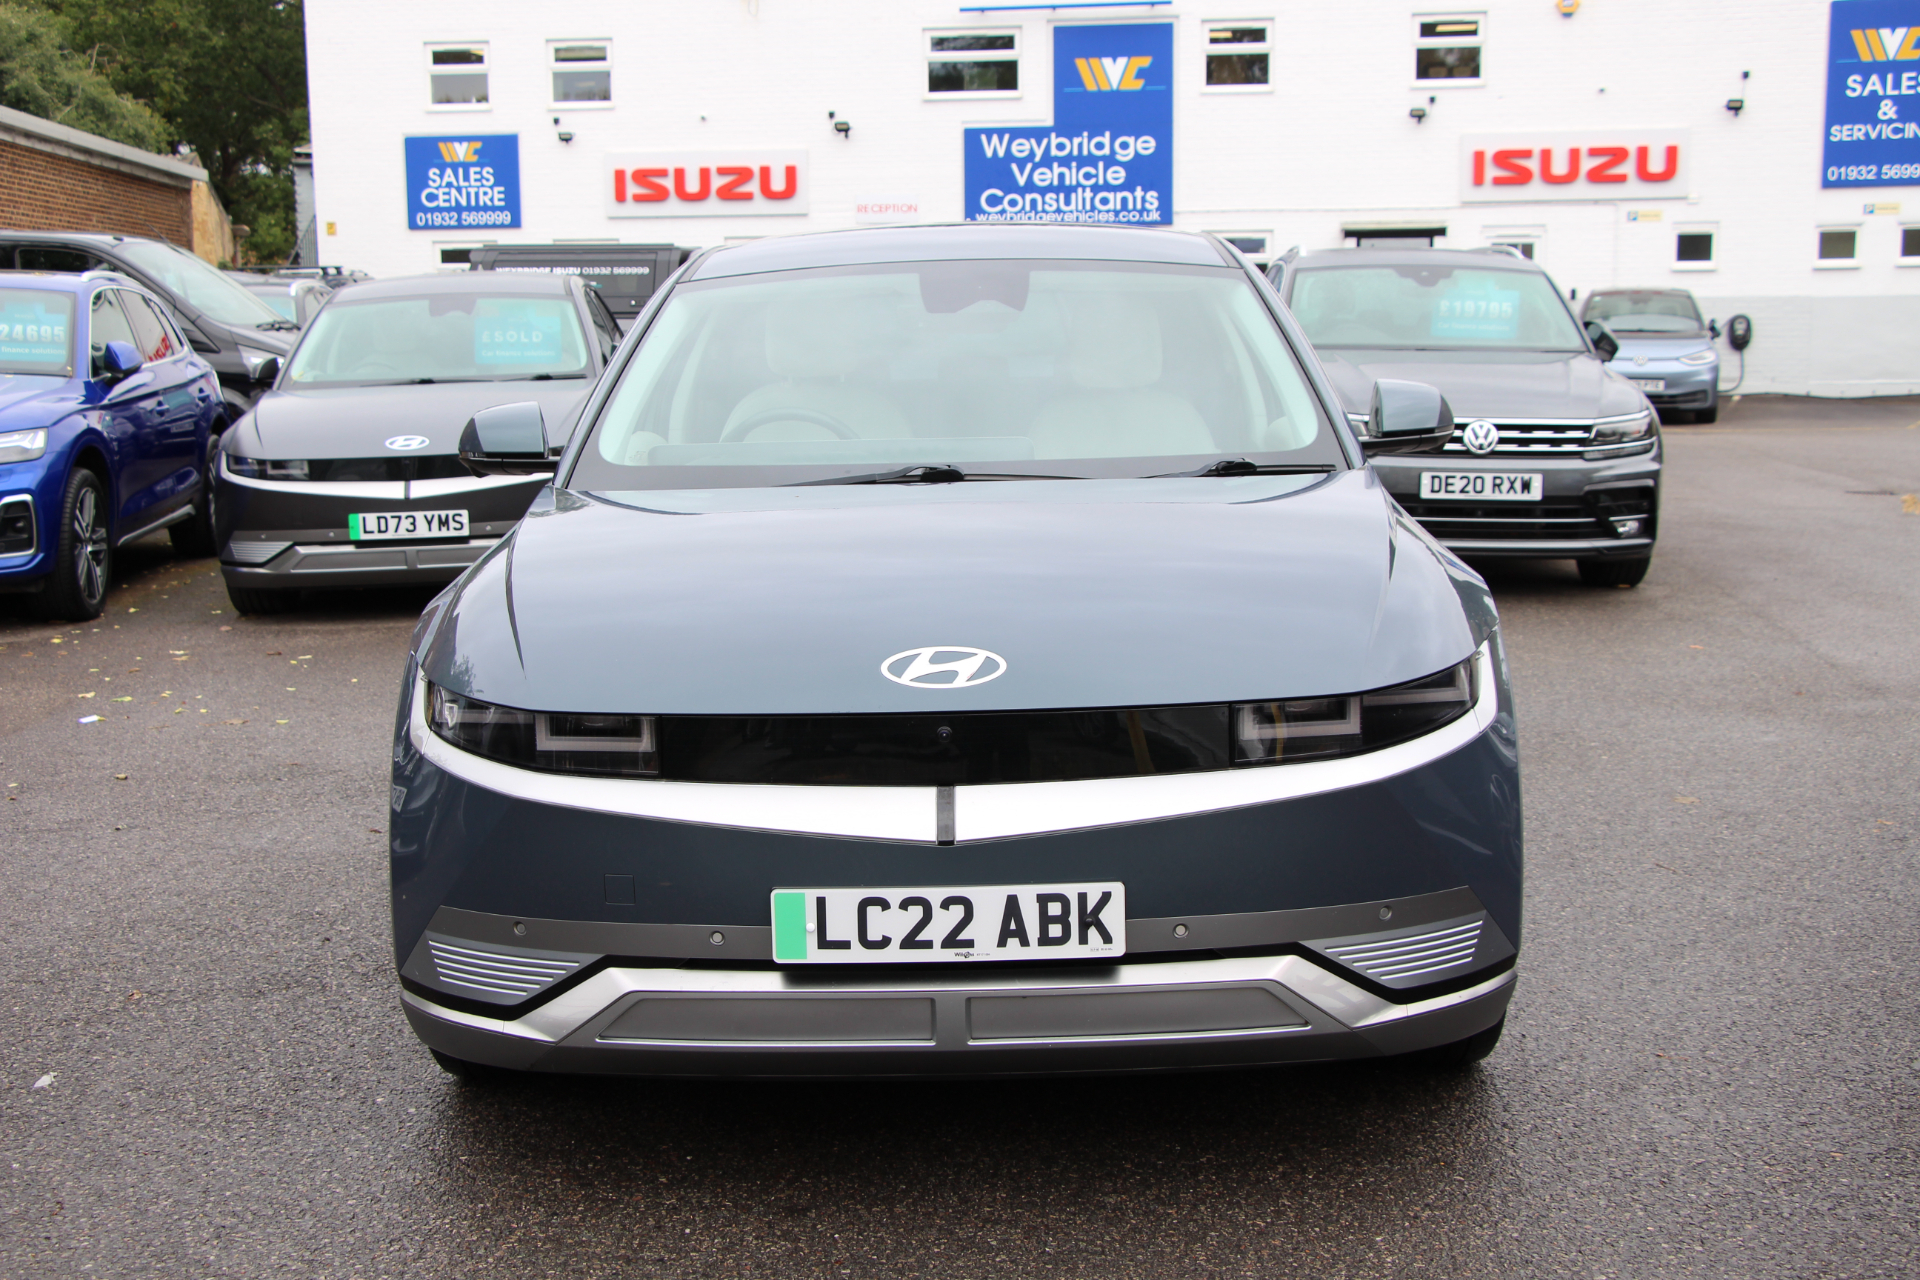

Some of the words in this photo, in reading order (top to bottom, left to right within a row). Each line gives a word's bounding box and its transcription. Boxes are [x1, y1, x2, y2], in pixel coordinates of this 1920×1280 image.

[1845, 71, 1920, 97] SALE
[1877, 98, 1898, 120] &
[980, 131, 1156, 162] Weybridge
[1010, 161, 1126, 187] Vehicle
[1473, 145, 1678, 186] ISUZU
[1827, 165, 1877, 181] 01932
[428, 166, 495, 188] SALES
[614, 165, 797, 203] ISUZU
[420, 186, 506, 208] CENTRE
[980, 186, 1159, 212] Consultants
[416, 211, 458, 226] 01932
[461, 210, 511, 225] 569999
[857, 204, 918, 213] RECEPTION
[552, 267, 581, 275] ISUZU
[582, 267, 611, 275] 01932
[613, 267, 650, 275] 569999
[1430, 475, 1485, 494] DE20
[1492, 476, 1532, 494] RXW
[362, 515, 417, 534] LD73
[423, 513, 464, 532] YMS
[816, 896, 975, 950] LC22
[996, 891, 1113, 948] ABK
